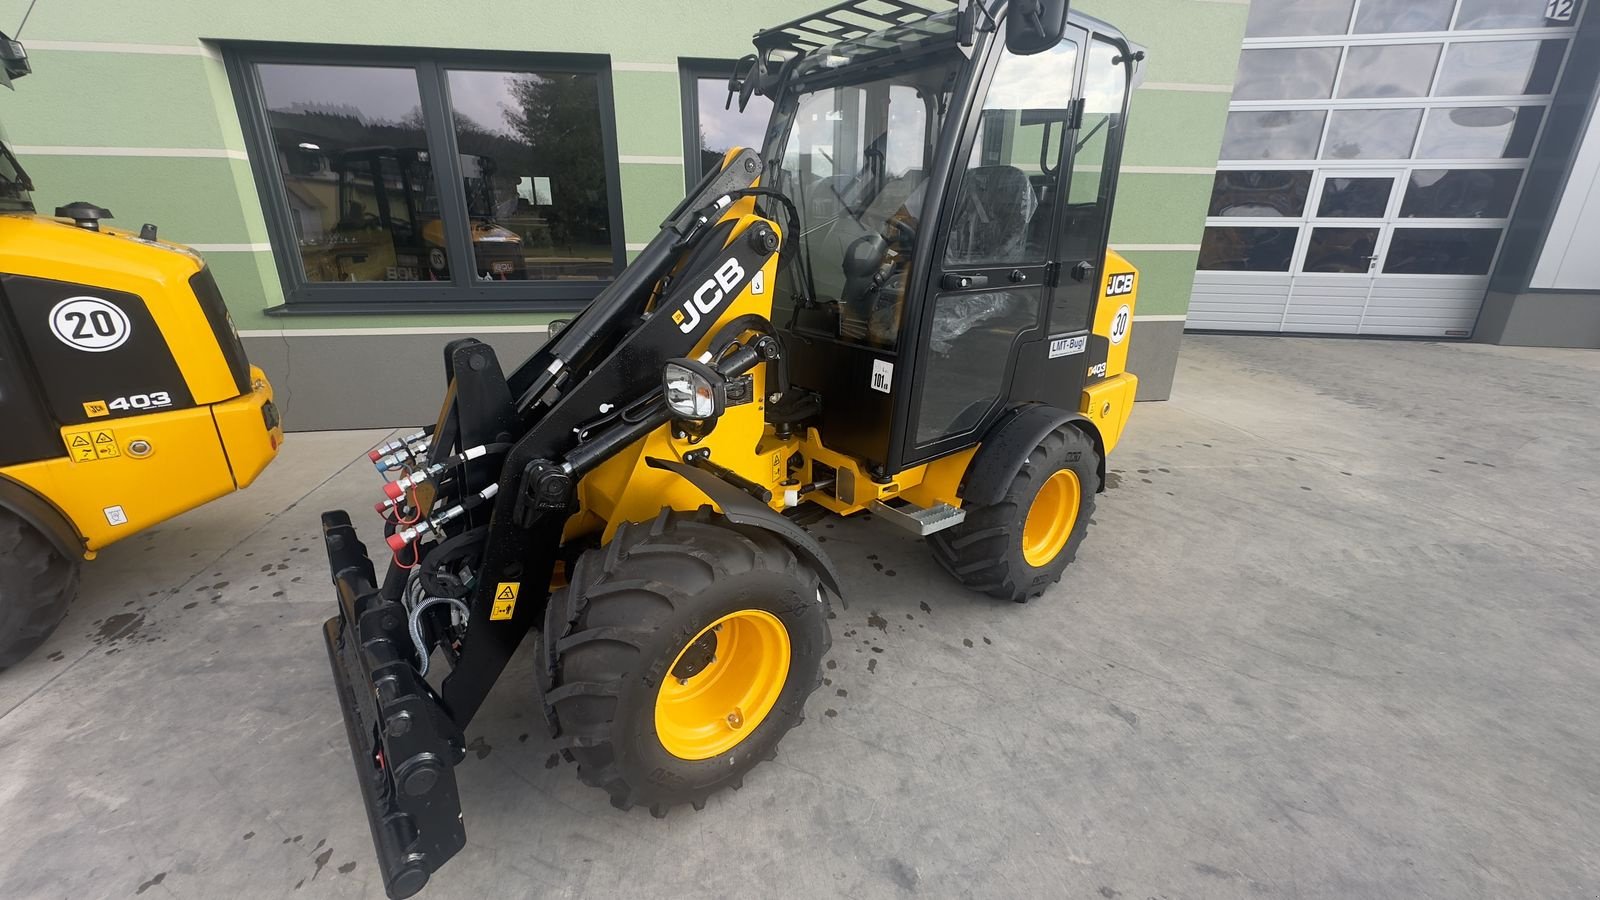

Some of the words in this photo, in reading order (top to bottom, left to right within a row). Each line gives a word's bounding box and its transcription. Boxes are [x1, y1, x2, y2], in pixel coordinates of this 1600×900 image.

[1550, 0, 1573, 18] 12
[680, 257, 745, 334] JCB
[1106, 274, 1134, 295] JCB
[64, 310, 117, 340] 20
[1113, 312, 1127, 337] 30
[109, 391, 171, 410] 403
